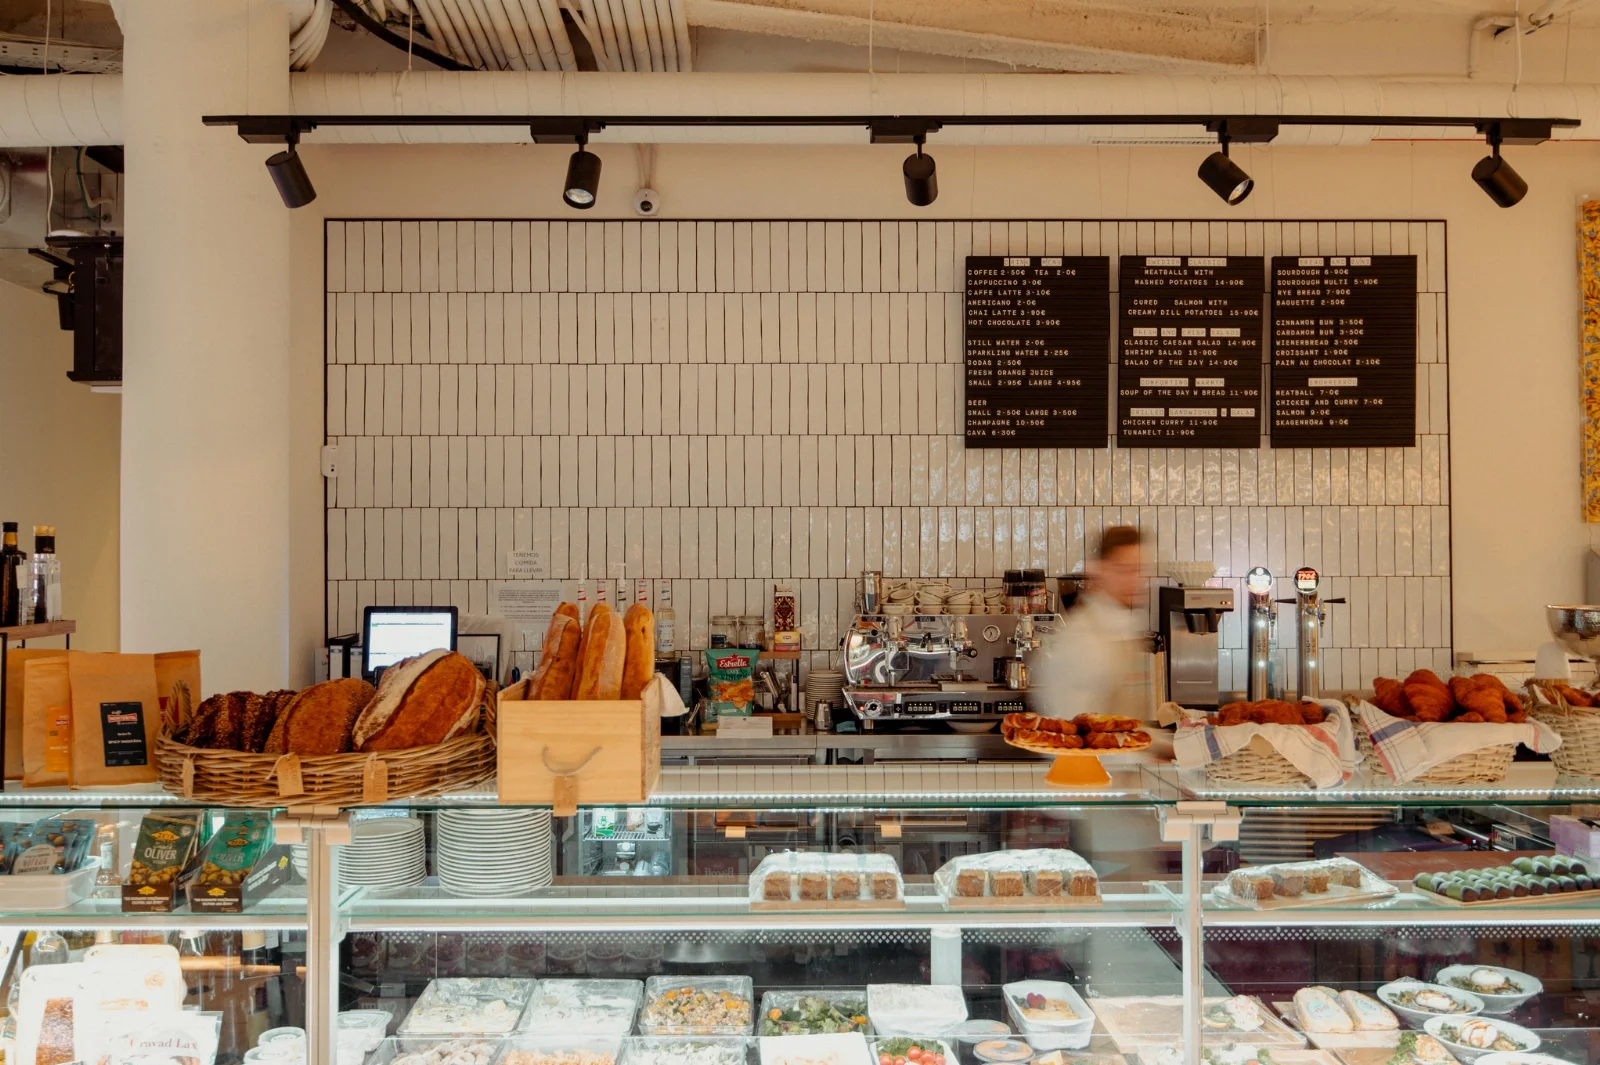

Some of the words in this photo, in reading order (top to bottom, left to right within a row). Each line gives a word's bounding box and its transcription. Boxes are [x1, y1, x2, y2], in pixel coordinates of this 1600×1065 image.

[1324, 278, 1348, 286] MULTI
[719, 658, 748, 668] Estrella
[157, 832, 175, 840] ZETA
[144, 847, 177, 860] OLIVER
[176, 1038, 199, 1050] Lax
